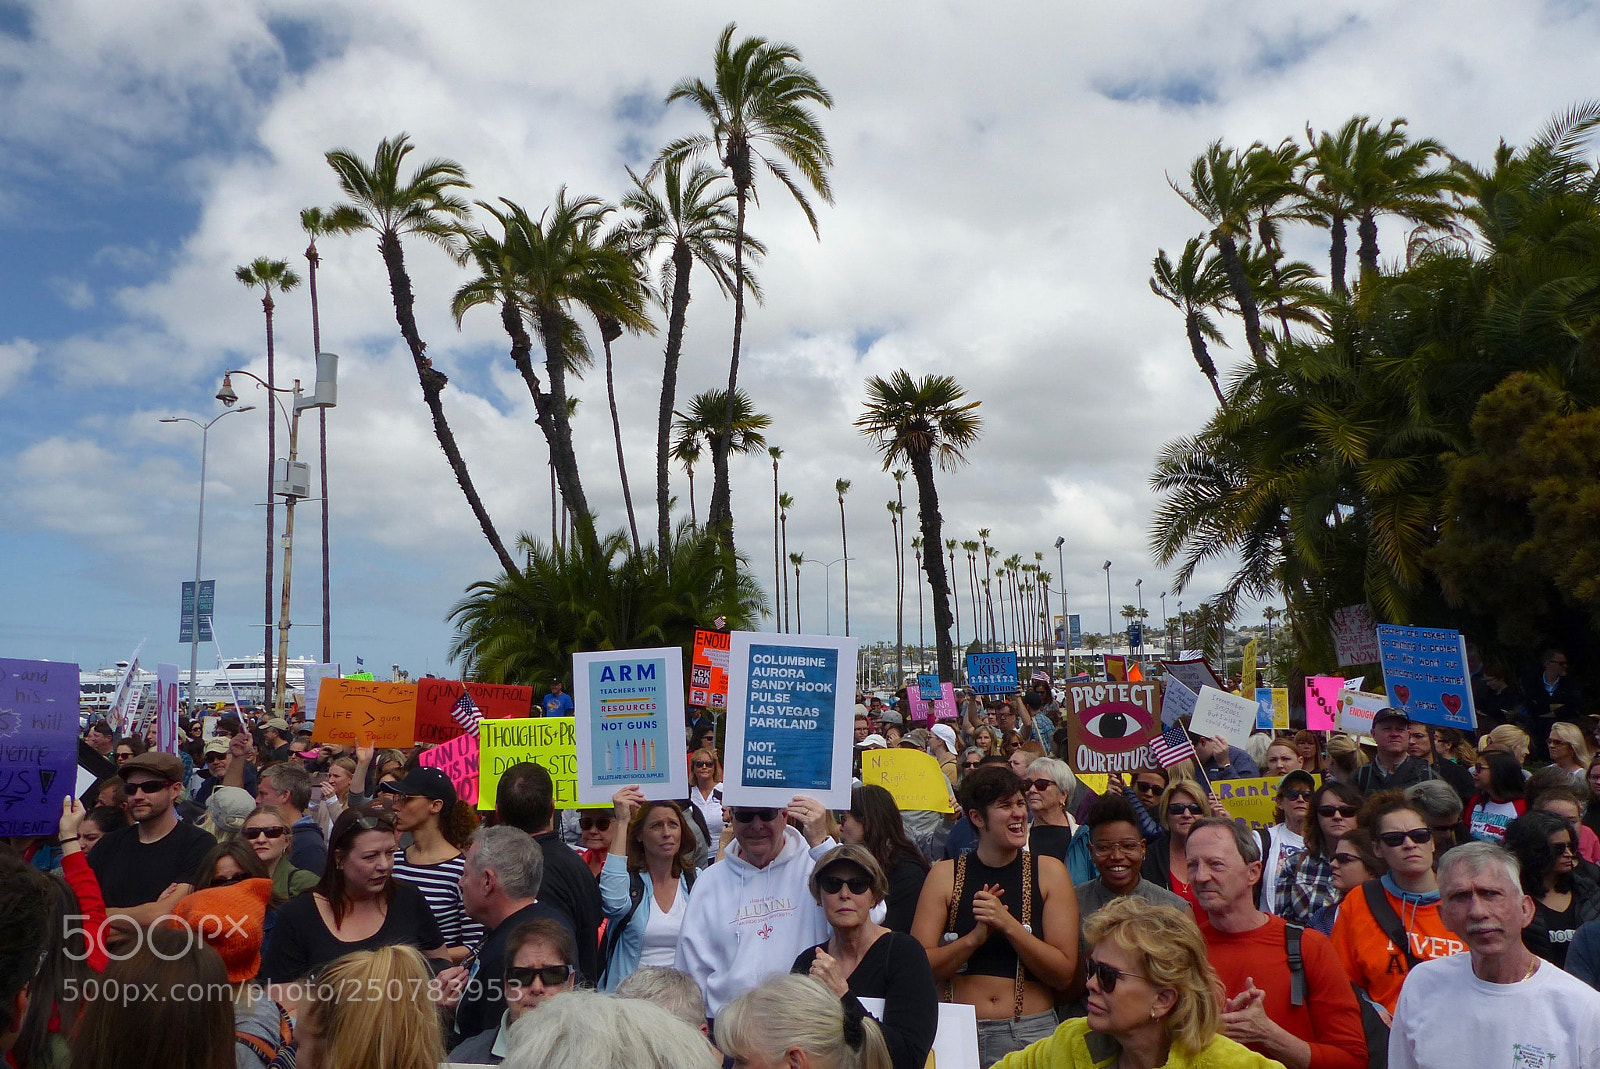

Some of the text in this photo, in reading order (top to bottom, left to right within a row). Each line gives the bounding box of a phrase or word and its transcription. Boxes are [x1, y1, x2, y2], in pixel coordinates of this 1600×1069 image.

[696, 632, 730, 649] ENOU
[1422, 630, 1446, 640] asked
[1448, 632, 1457, 640] to
[1418, 642, 1427, 652] to
[1430, 644, 1458, 653] protect
[752, 654, 826, 667] COLUMBINE
[972, 655, 1011, 666] Protect
[1350, 650, 1378, 663] NOW
[600, 663, 656, 682] ARM
[752, 667, 806, 679] AURORA
[979, 664, 1006, 675] KIDS
[692, 676, 709, 685] NRA
[1425, 672, 1439, 682] the
[751, 680, 832, 693] SANDY HOOK
[15, 688, 41, 704] his
[426, 684, 460, 706] GUN
[750, 692, 791, 703] PULSE
[1070, 684, 1155, 714] PROTECT
[601, 703, 657, 712] RESOURCES
[750, 705, 820, 717] LAS VEGAS
[32, 712, 61, 730] will
[323, 706, 353, 719] LIFE
[380, 715, 401, 727] guns
[601, 720, 658, 731] NOT GUNS
[749, 717, 818, 730] PARKLAND
[425, 733, 470, 767] CAN U
[747, 741, 777, 753] NOT.
[746, 755, 777, 766] ONE.
[871, 755, 896, 769] Not
[746, 769, 786, 780] MORE.
[1229, 798, 1263, 807] Gordon
